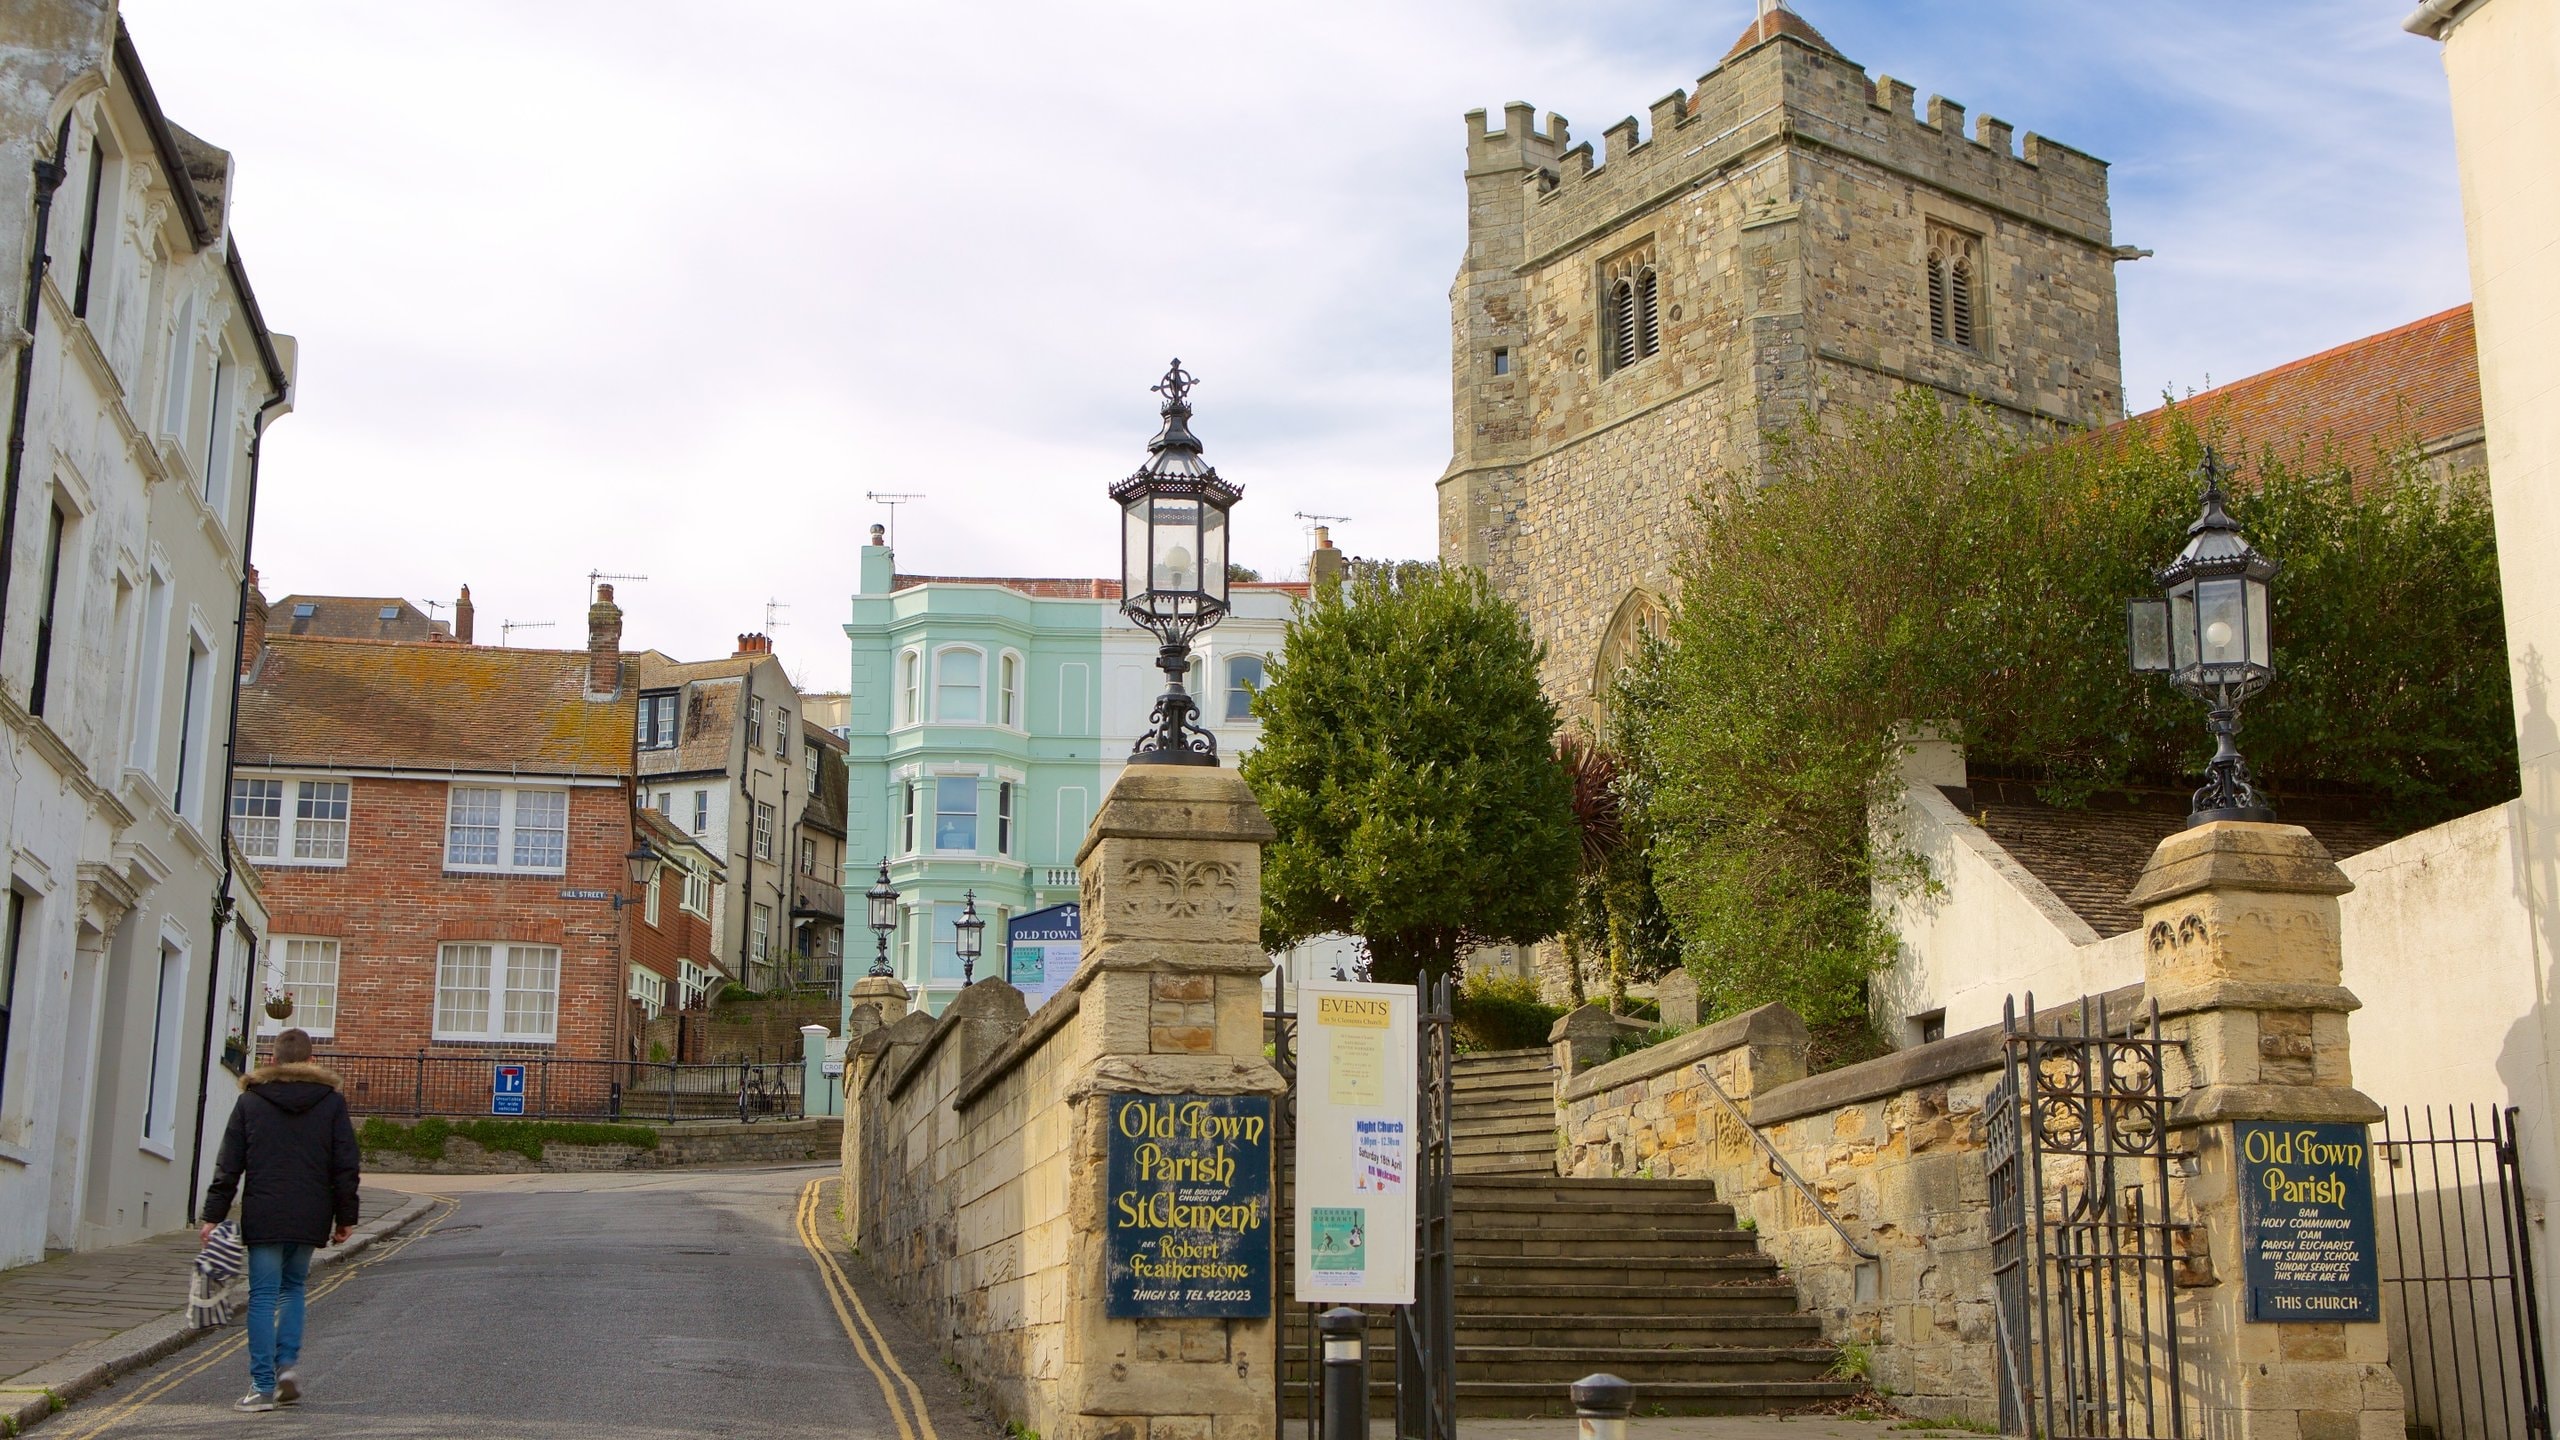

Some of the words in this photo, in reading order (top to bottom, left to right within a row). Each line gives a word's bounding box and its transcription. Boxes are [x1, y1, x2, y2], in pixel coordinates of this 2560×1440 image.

[1015, 930, 1039, 940] OLD
[1042, 930, 1078, 940] TOWN
[1321, 998, 1387, 1015] EVENTS
[1119, 1100, 1175, 1139] Old
[1180, 1101, 1264, 1146] Town
[1357, 1121, 1376, 1134] Night
[1377, 1121, 1403, 1133] Church
[2244, 1129, 2292, 1164] Old
[2295, 1130, 2362, 1170] Town
[1134, 1142, 1236, 1188] Parish
[1359, 1146, 1379, 1164] Saturday
[1391, 1158, 1402, 1170] April
[1377, 1168, 1400, 1183] Welcome
[2262, 1168, 2346, 1210] Parish
[2298, 1208, 2318, 1218] 8AM
[2261, 1218, 2286, 1228] HOLY
[2290, 1218, 2351, 1229] COMMUNION
[2297, 1230, 2322, 1240] 10AM
[1159, 1235, 1220, 1259] Robert
[2261, 1240, 2295, 1250] PARISH
[2300, 1241, 2355, 1250] EUCHARIST
[2262, 1251, 2283, 1260] WITH
[2286, 1252, 2321, 1261] SUNDAY
[2324, 1252, 2360, 1262] SCHOOL
[1130, 1254, 1248, 1282] Featherstone
[2274, 1262, 2308, 1271] SUNDAY
[2310, 1263, 2351, 1272] SERVICES
[2274, 1271, 2292, 1280] THIS
[2294, 1272, 2317, 1281] WEEK
[2319, 1272, 2336, 1281] ARE
[2339, 1273, 2350, 1281] IN
[2275, 1296, 2301, 1309] THIS
[2306, 1297, 2358, 1310] CHURCH
